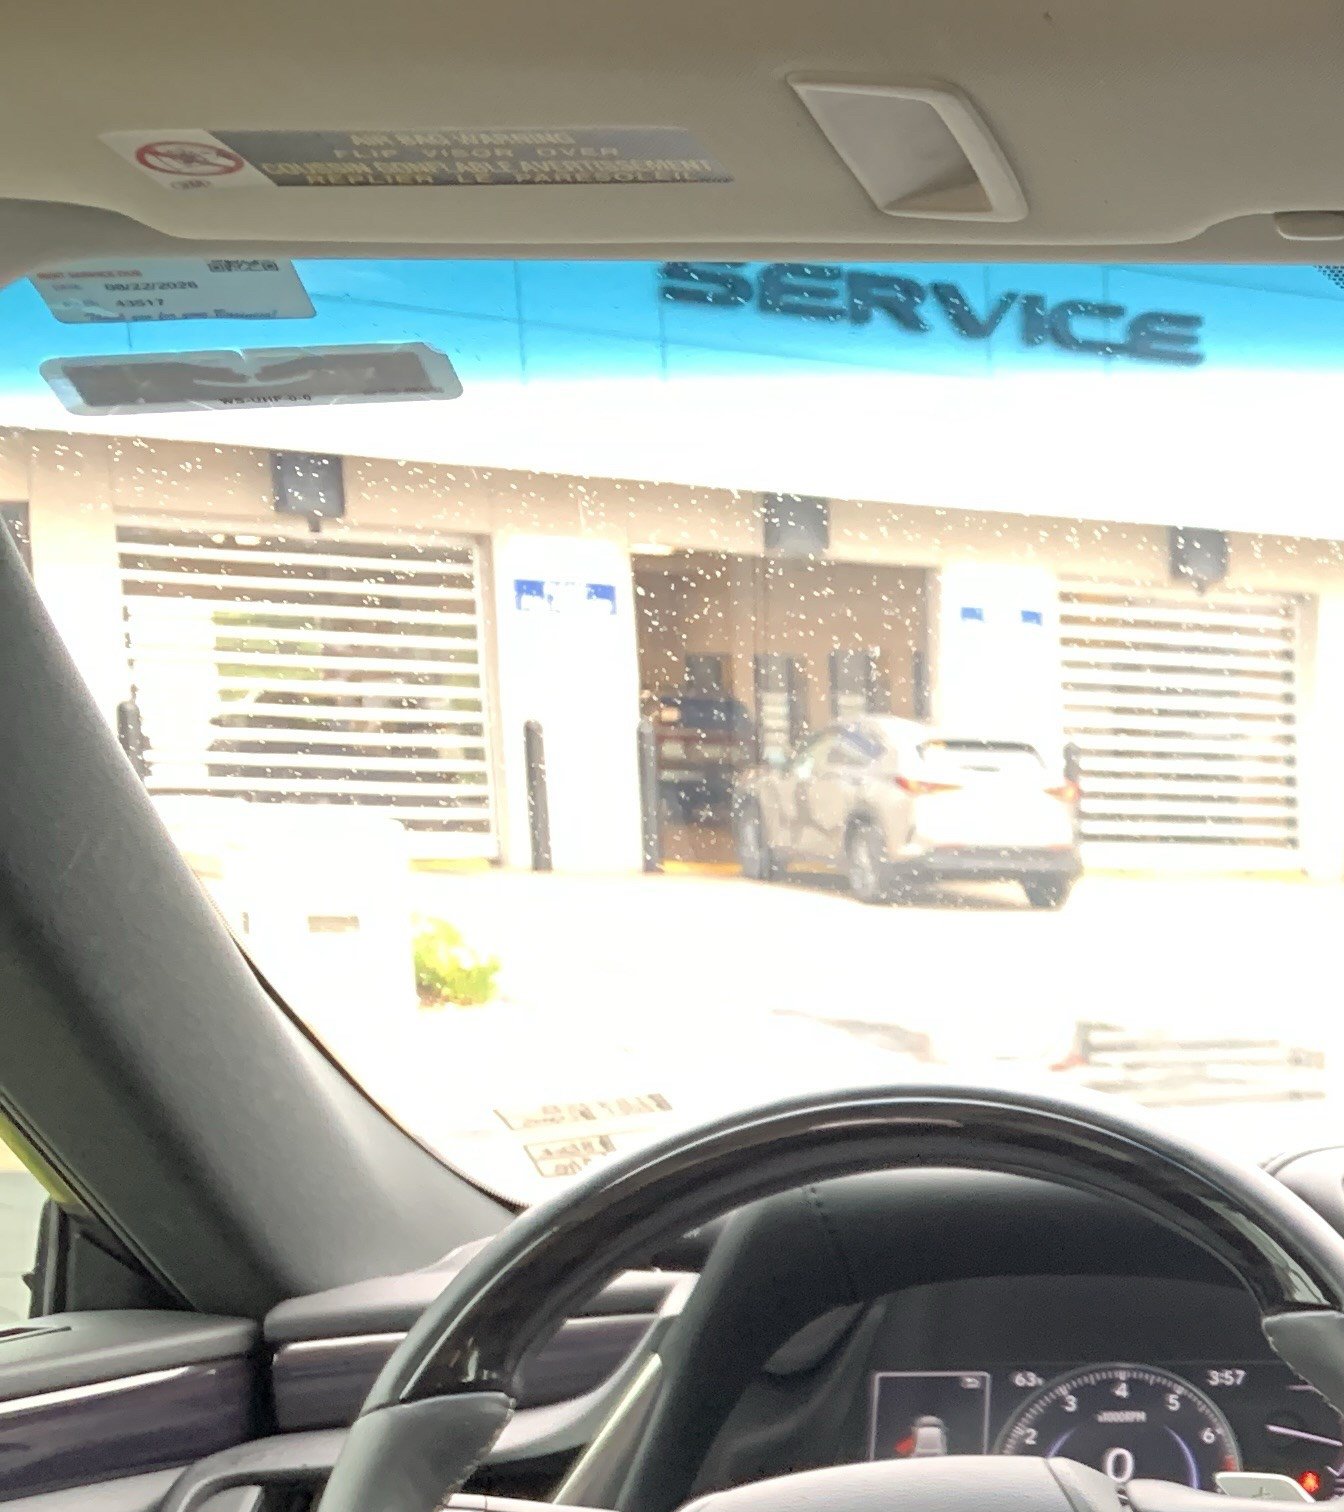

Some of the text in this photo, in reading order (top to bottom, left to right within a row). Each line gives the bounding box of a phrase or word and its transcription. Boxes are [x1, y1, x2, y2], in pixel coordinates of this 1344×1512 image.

[658, 261, 1206, 364] SERVICE
[1207, 1369, 1248, 1386] 3:57
[1114, 1383, 1128, 1399] 4
[1063, 1396, 1078, 1413] 3
[1166, 1394, 1181, 1411] 5
[1023, 1429, 1037, 1446] 2
[1202, 1429, 1216, 1444] 6
[1104, 1446, 1135, 1482] 0
